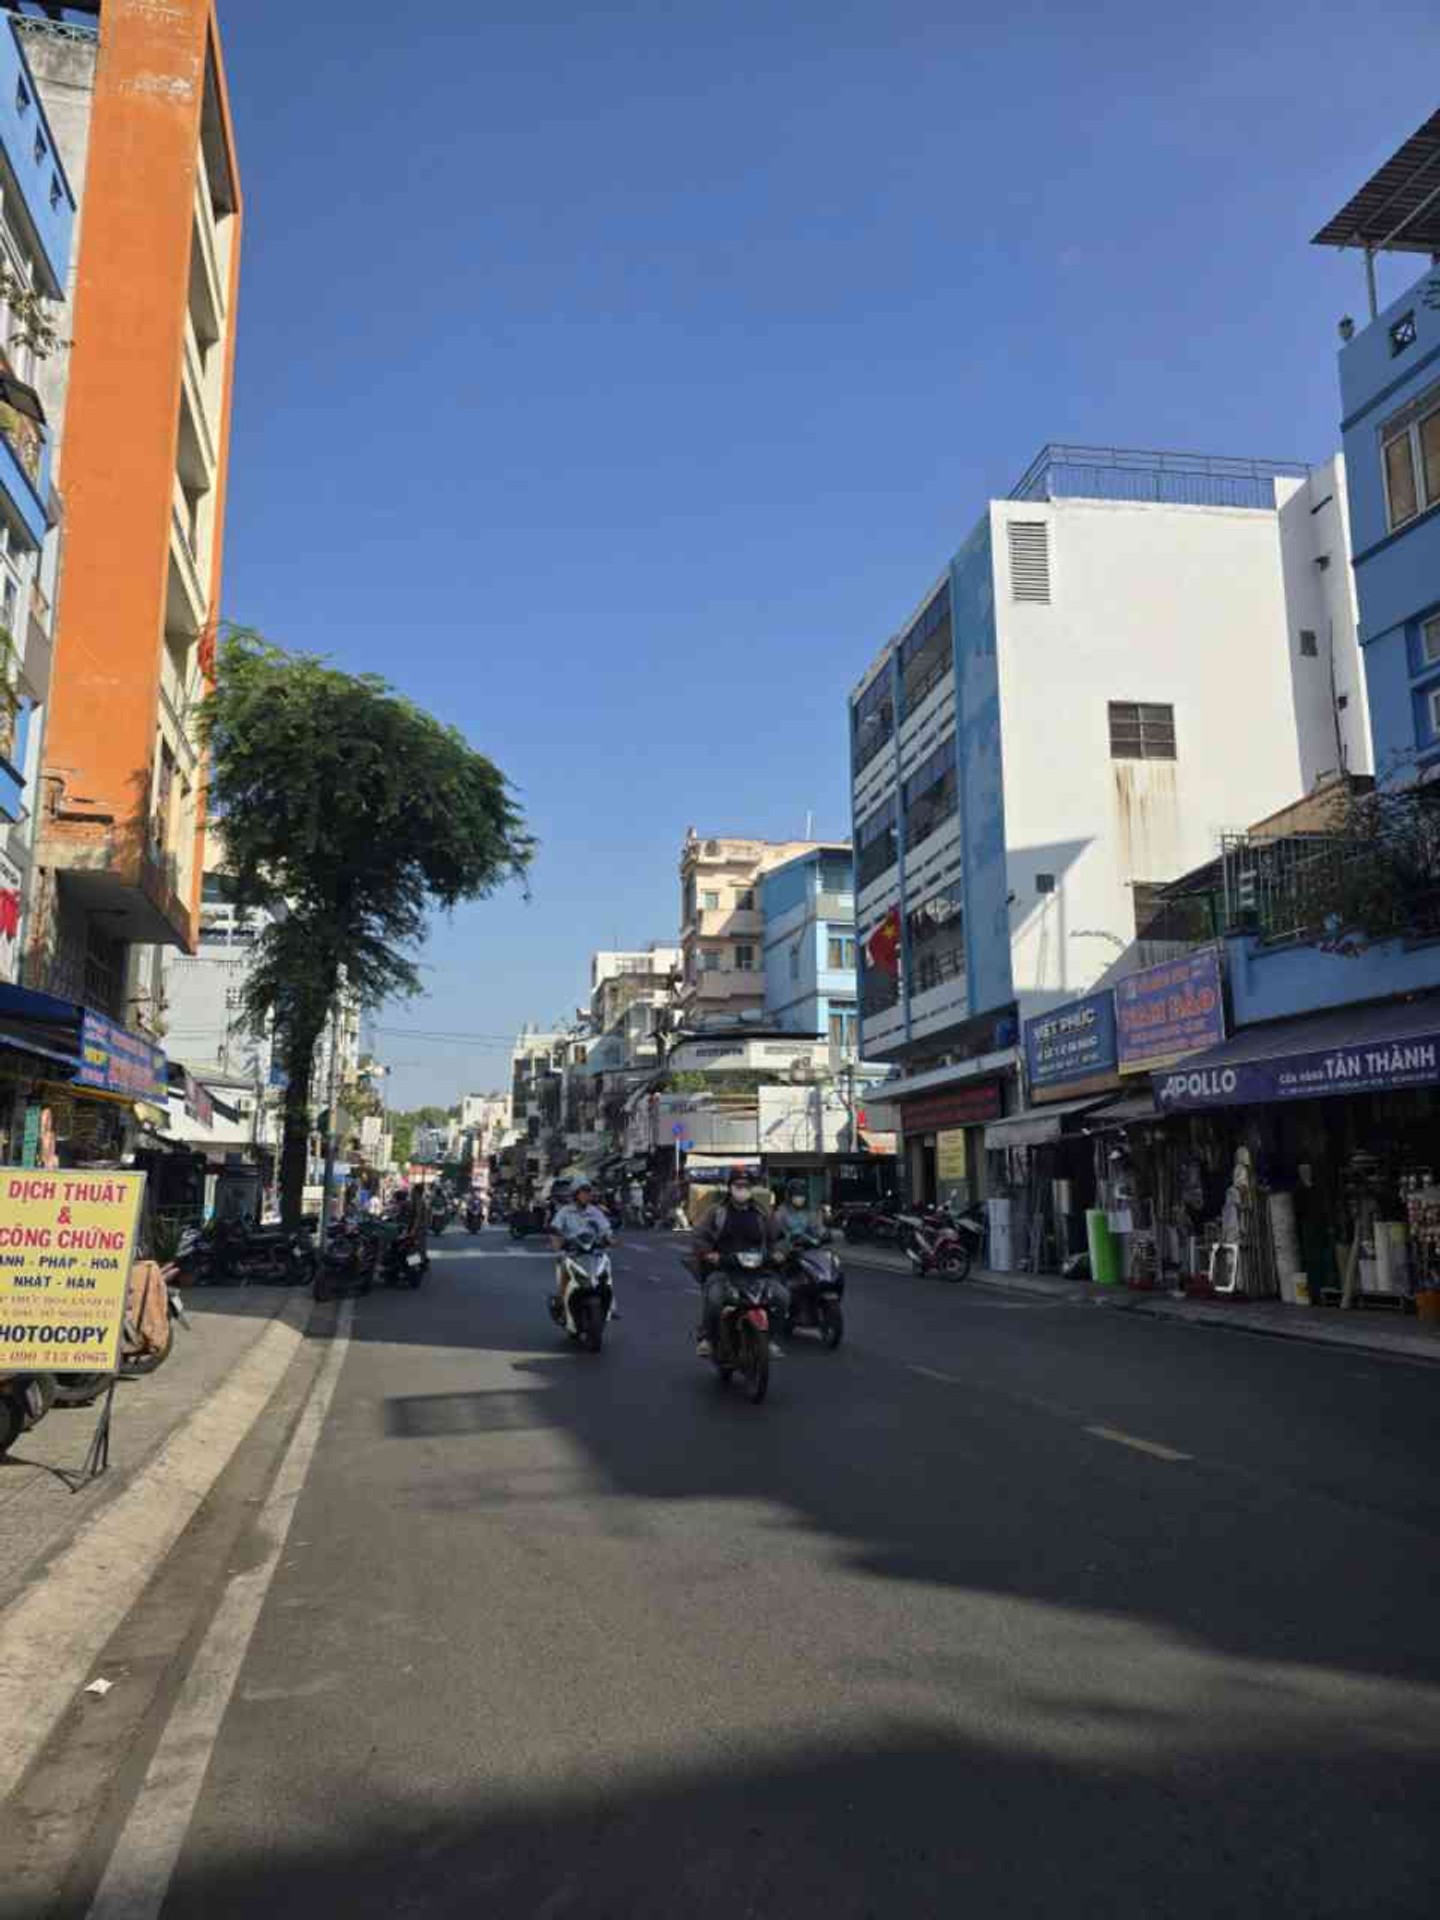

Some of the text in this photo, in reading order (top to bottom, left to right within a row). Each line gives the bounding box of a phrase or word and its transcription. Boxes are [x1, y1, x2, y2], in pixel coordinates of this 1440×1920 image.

[1324, 1052, 1361, 1079] TÂN
[1365, 1044, 1436, 1074] THÀNH
[1161, 1068, 1237, 1101] APOLLO
[8, 1179, 127, 1204] DỊCH THUẬT
[57, 1206, 71, 1224] &
[0, 1223, 126, 1250] CÔNG CHỨNG
